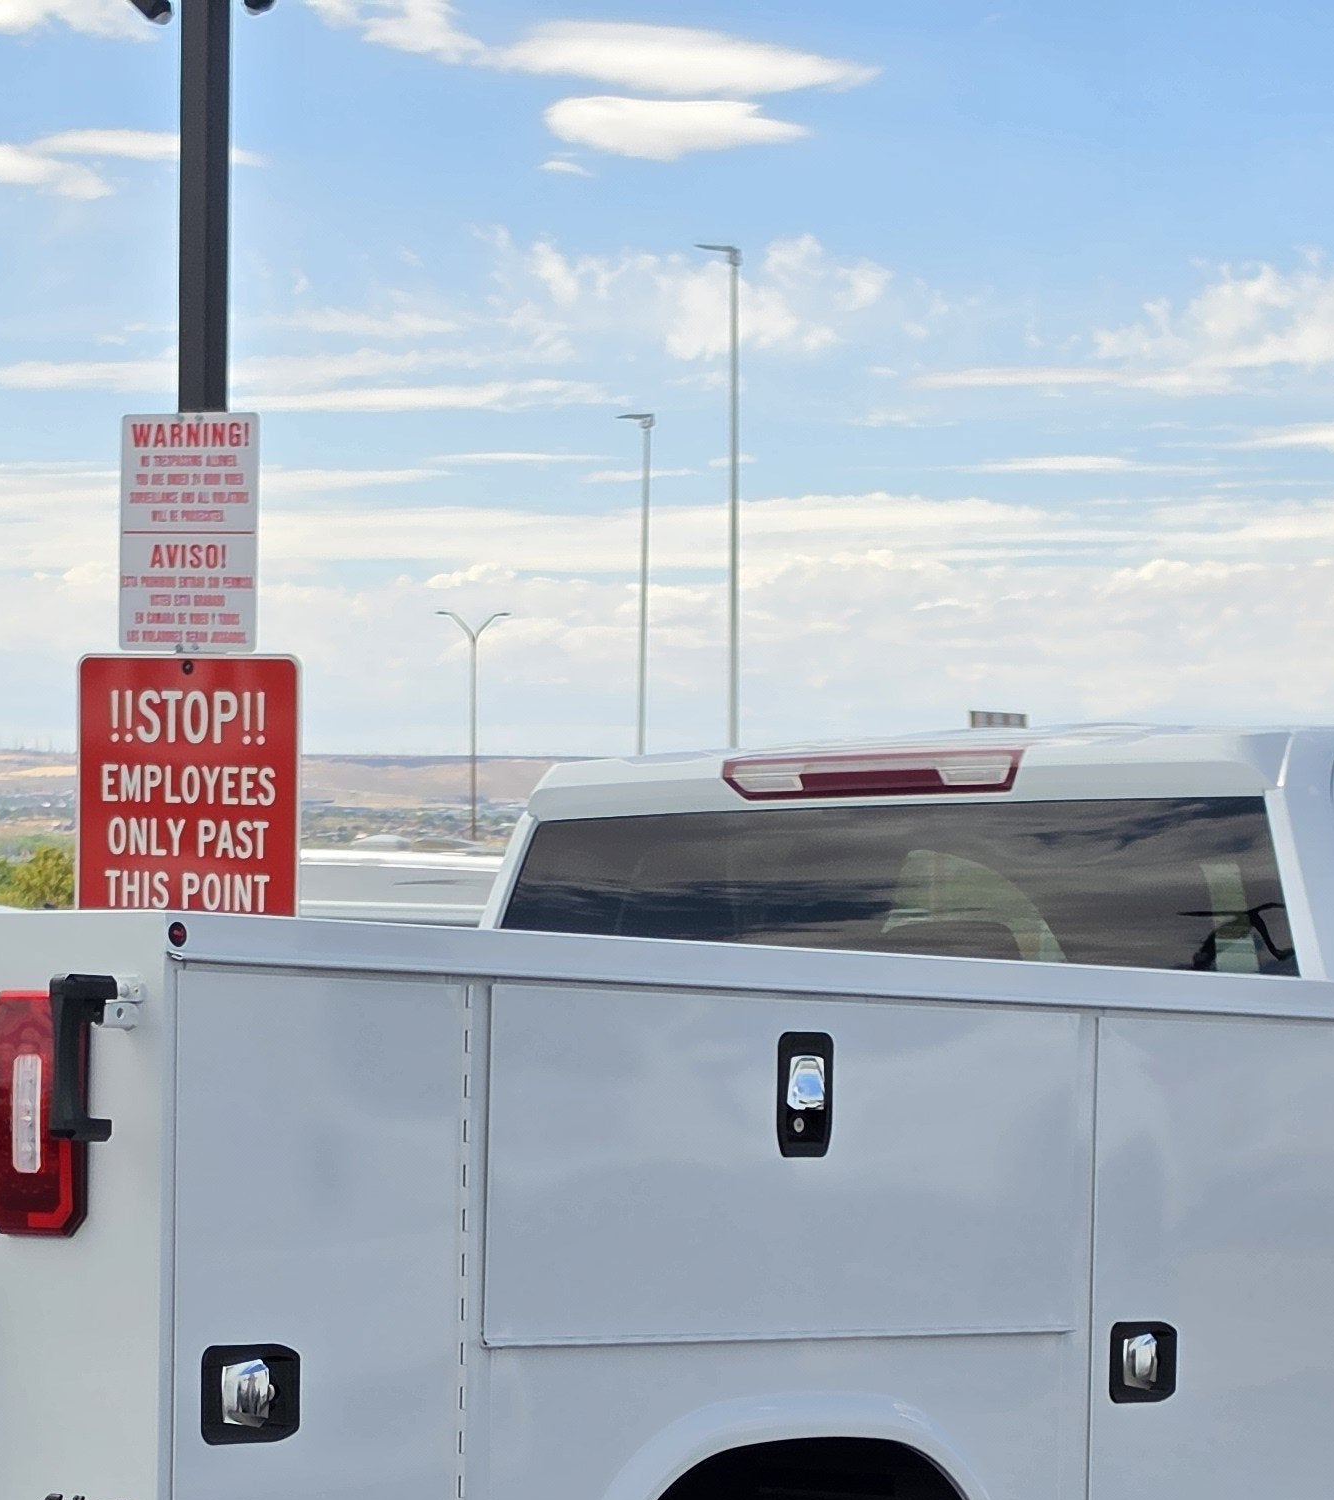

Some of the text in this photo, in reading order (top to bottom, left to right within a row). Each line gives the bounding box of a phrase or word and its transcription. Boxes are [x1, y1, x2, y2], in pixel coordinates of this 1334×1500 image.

[131, 422, 250, 448] WARNING!
[149, 544, 227, 569] AVISO!
[110, 689, 266, 746] !!STOP!!
[101, 763, 276, 806] EMPLOYEES
[107, 816, 269, 860] ONLY PAST
[104, 869, 270, 913] THIS POINT
